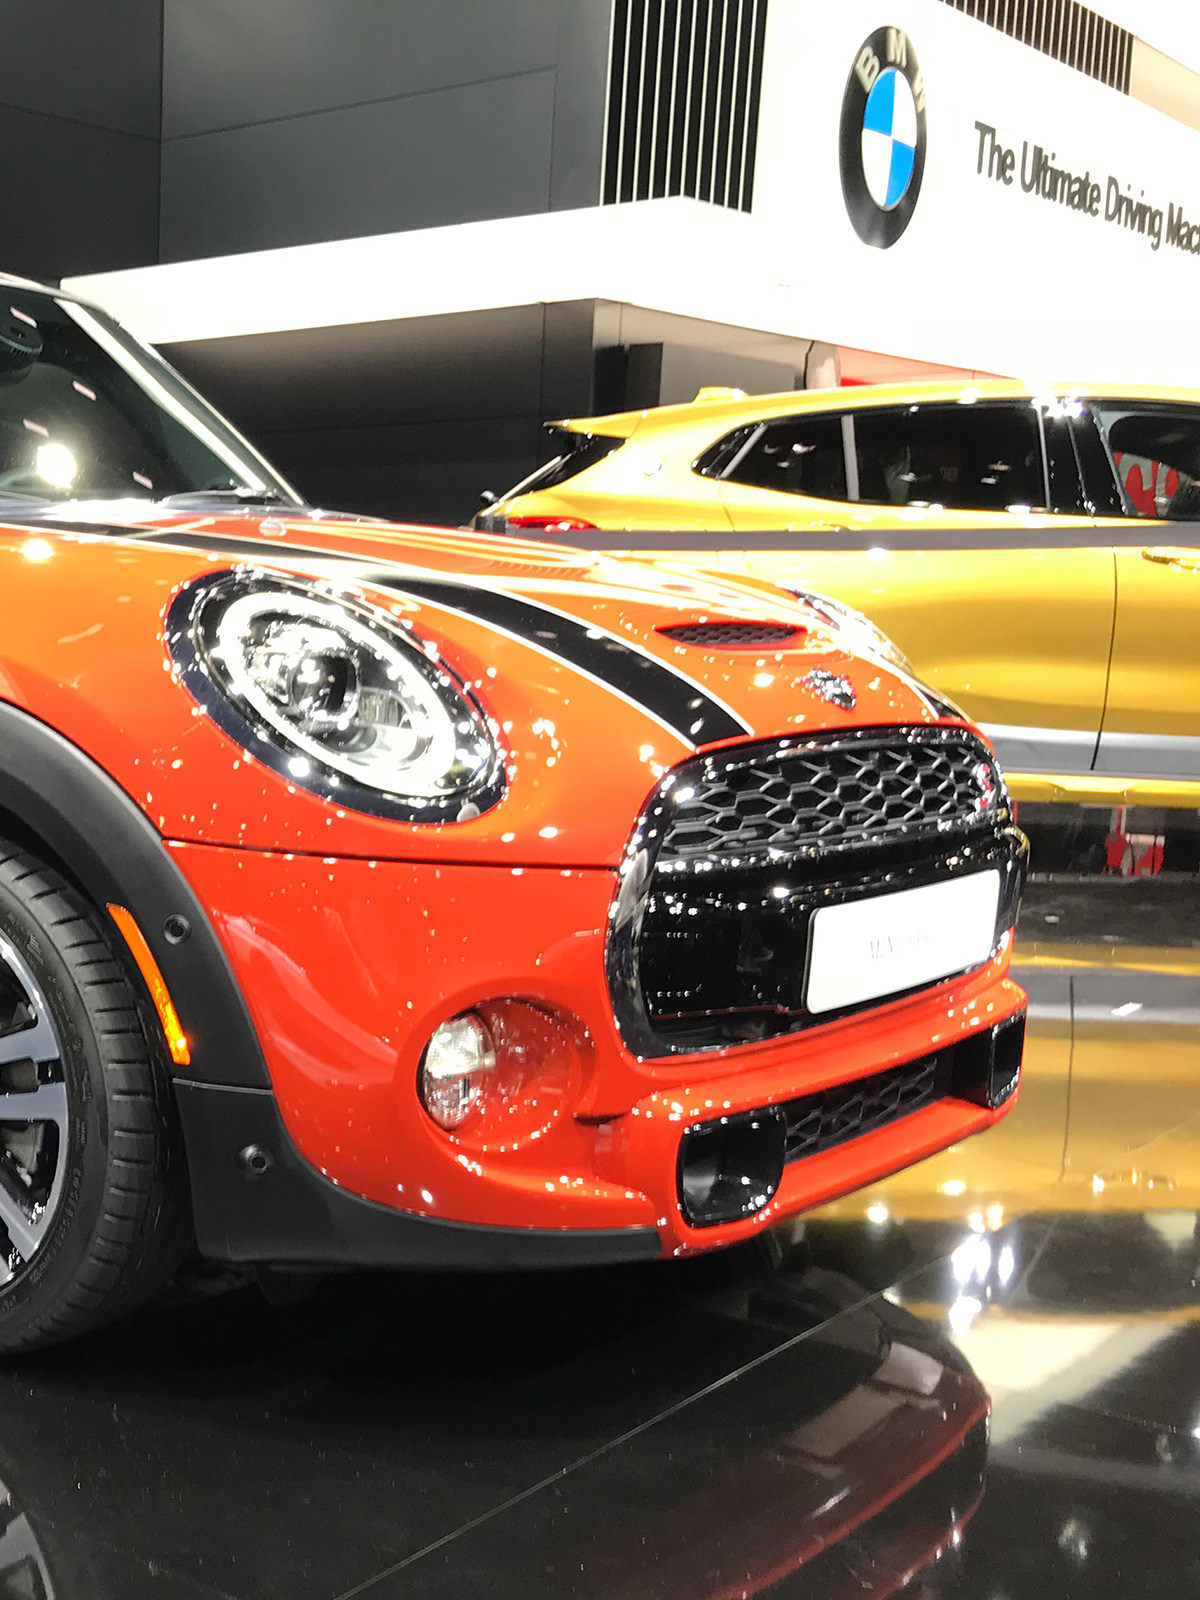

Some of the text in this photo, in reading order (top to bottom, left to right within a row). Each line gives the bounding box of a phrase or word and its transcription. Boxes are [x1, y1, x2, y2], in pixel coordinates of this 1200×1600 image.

[855, 28, 926, 113] BMW
[974, 120, 1200, 256] The Ultimate Driving Mac
